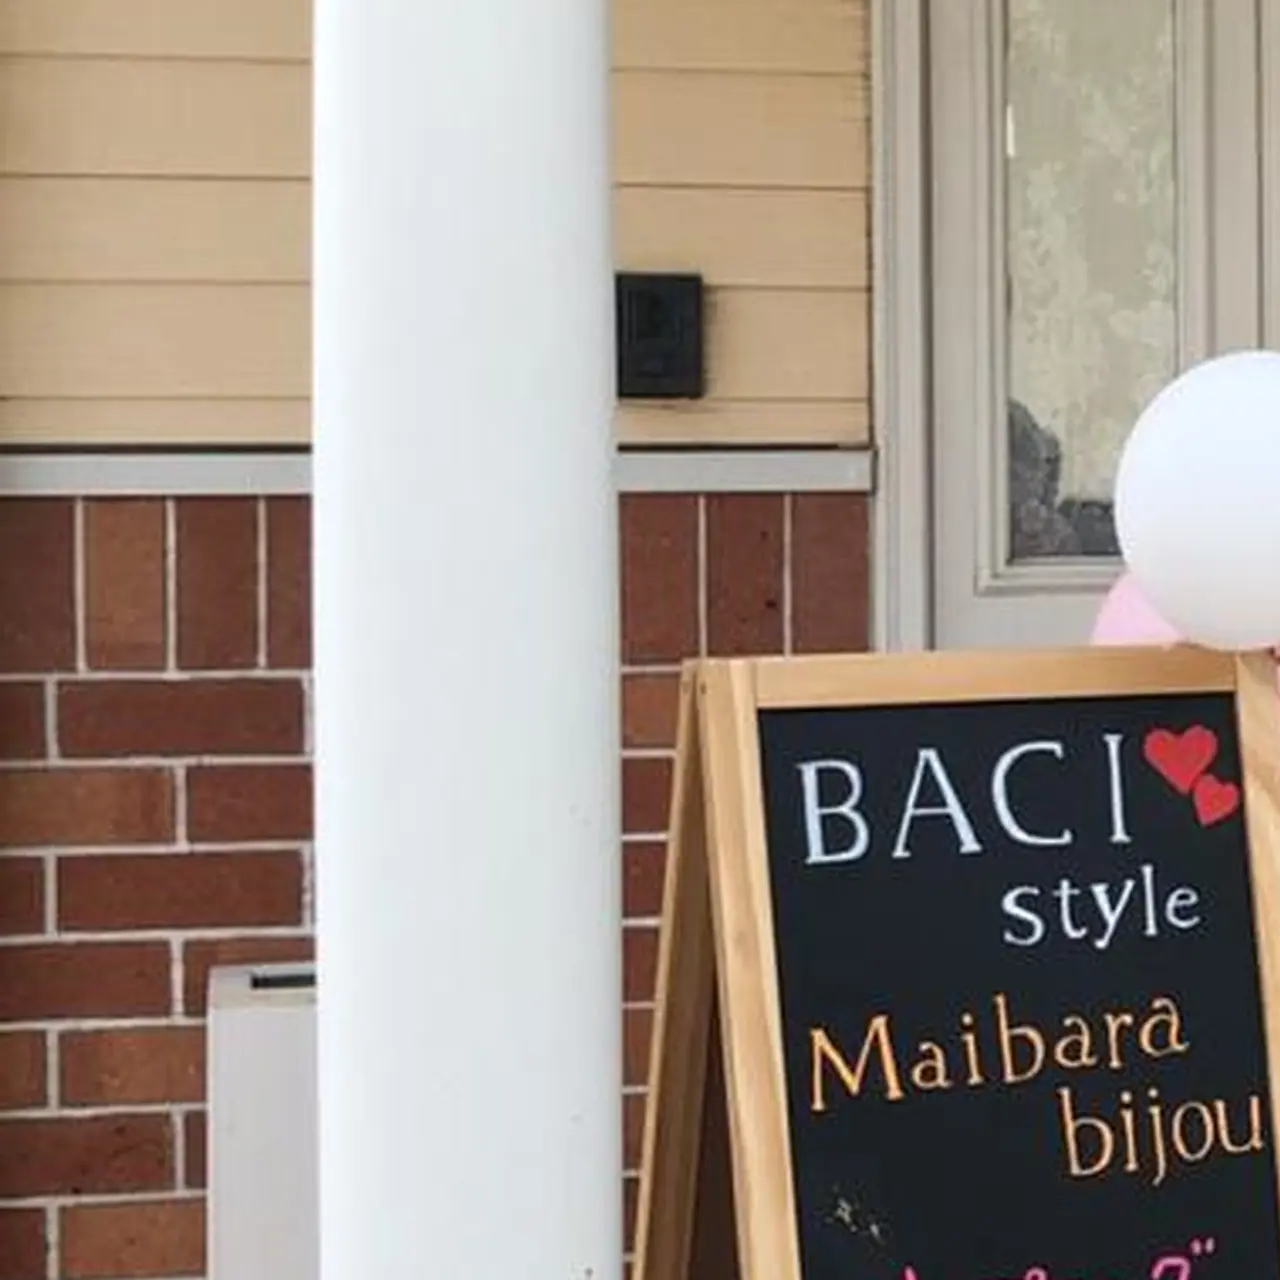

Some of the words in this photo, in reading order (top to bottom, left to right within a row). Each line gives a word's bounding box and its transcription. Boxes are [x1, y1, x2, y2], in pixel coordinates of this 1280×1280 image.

[796, 732, 1131, 865] BACI
[1002, 864, 1200, 949] style
[808, 993, 1189, 1112] Maibara
[1058, 1086, 1264, 1186] bijou
